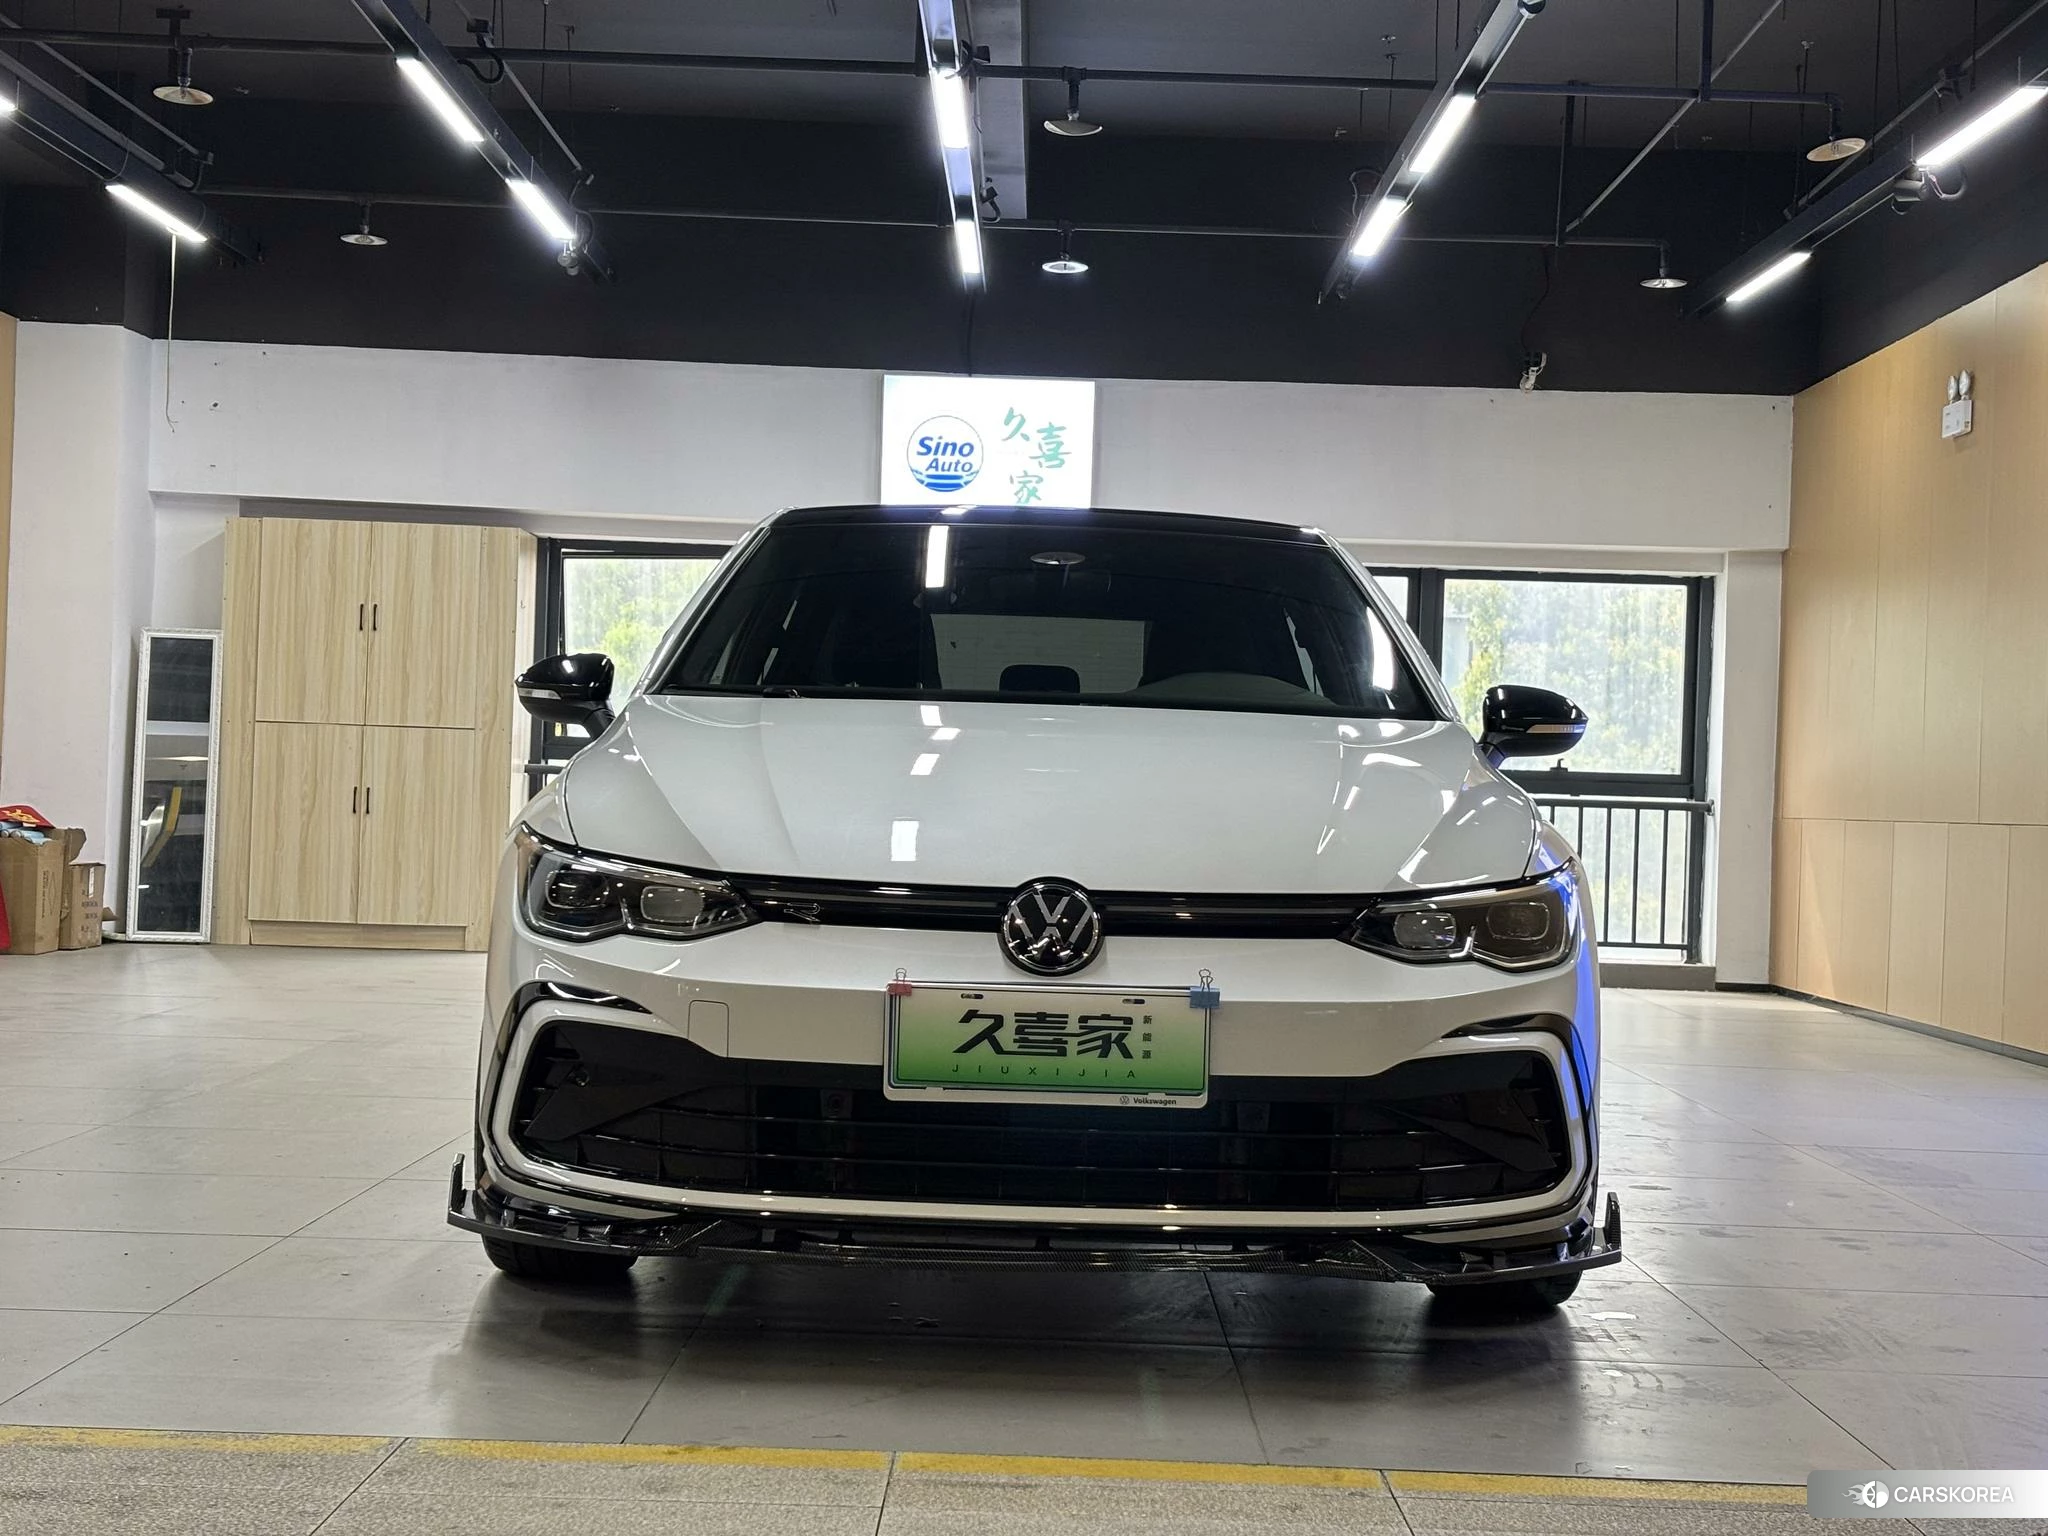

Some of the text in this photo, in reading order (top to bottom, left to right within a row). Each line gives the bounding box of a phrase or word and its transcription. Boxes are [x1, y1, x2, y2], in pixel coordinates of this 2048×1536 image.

[916, 436, 974, 457] Sino
[925, 458, 973, 473] Auto
[952, 1009, 1134, 1059] 久喜家
[952, 1064, 1136, 1078] JIUXIJIA
[1133, 1096, 1177, 1106] Volkswagen
